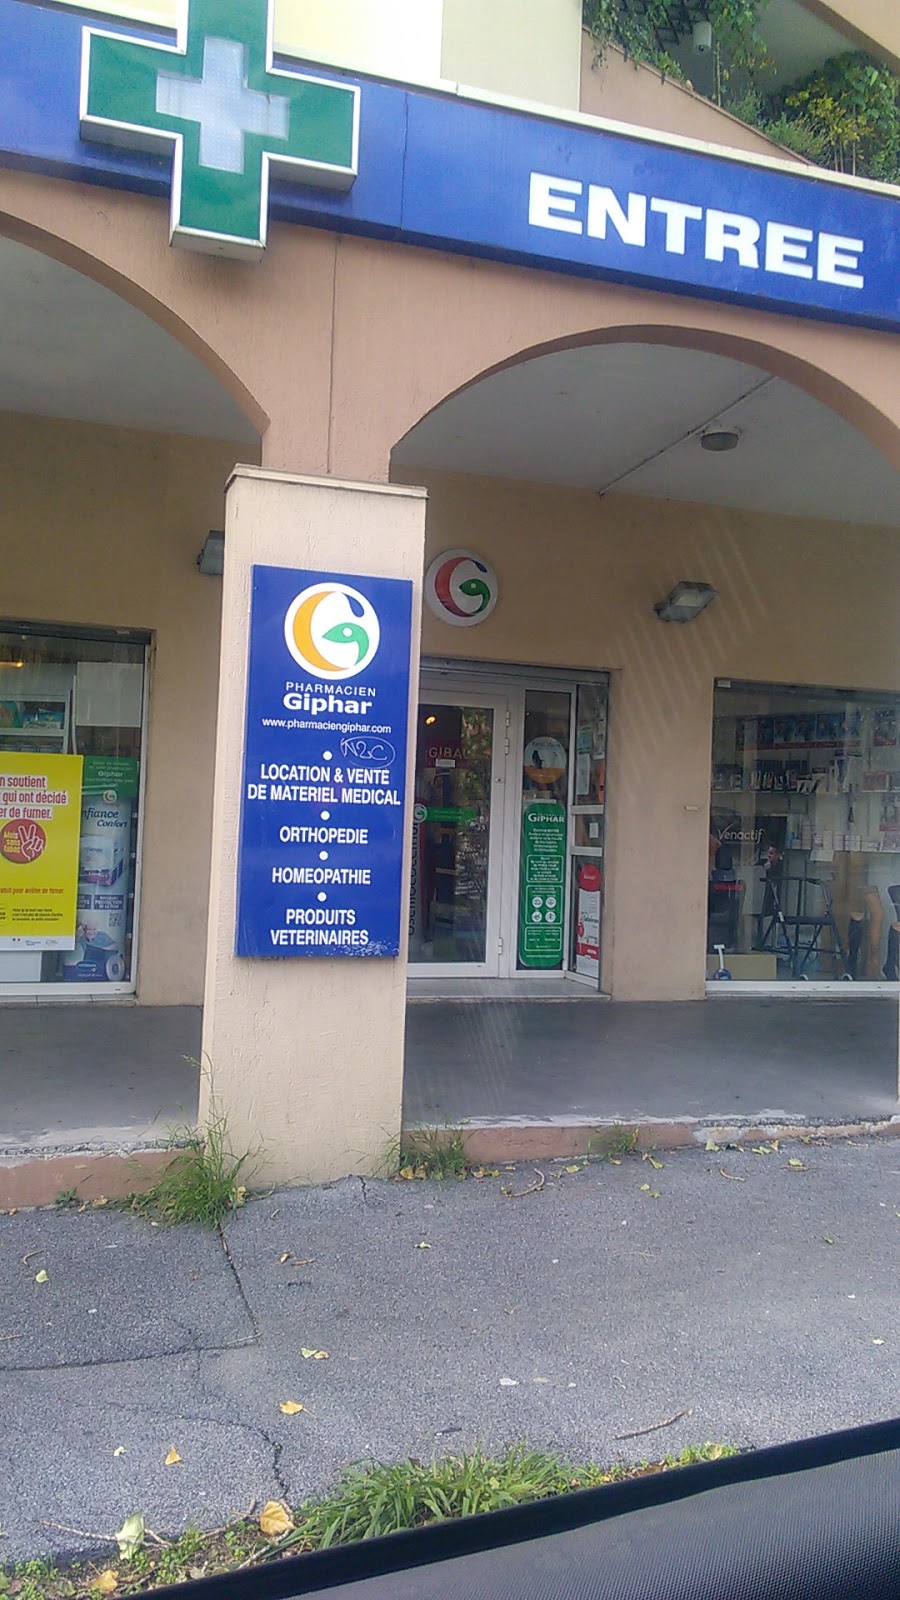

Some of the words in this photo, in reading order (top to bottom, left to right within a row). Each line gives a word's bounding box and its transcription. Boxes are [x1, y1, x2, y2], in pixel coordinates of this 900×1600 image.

[528, 172, 864, 289] ENTREE
[285, 682, 376, 697] PHARMACIEN
[283, 692, 372, 715] Giphar
[262, 718, 391, 733] www.pharmaciengiphar.com
[8, 775, 46, 788] soutient
[260, 764, 331, 782] LOCATION
[334, 768, 343, 783] &
[347, 768, 390, 785] VENTE
[3, 791, 17, 805] qui
[19, 793, 34, 803] ont
[36, 790, 67, 804] décidé
[247, 784, 267, 800] DE
[270, 785, 338, 803] MATERIEL
[341, 788, 401, 805] MEDICAL
[9, 806, 20, 818] de
[23, 807, 52, 819] fumer.
[97, 819, 127, 828] Confort
[279, 826, 369, 844] ORTHOPEDIE
[271, 867, 371, 885] HOMEOPATHIE
[286, 909, 356, 925] PRODUITS
[270, 929, 369, 946] VETERINAIRES
